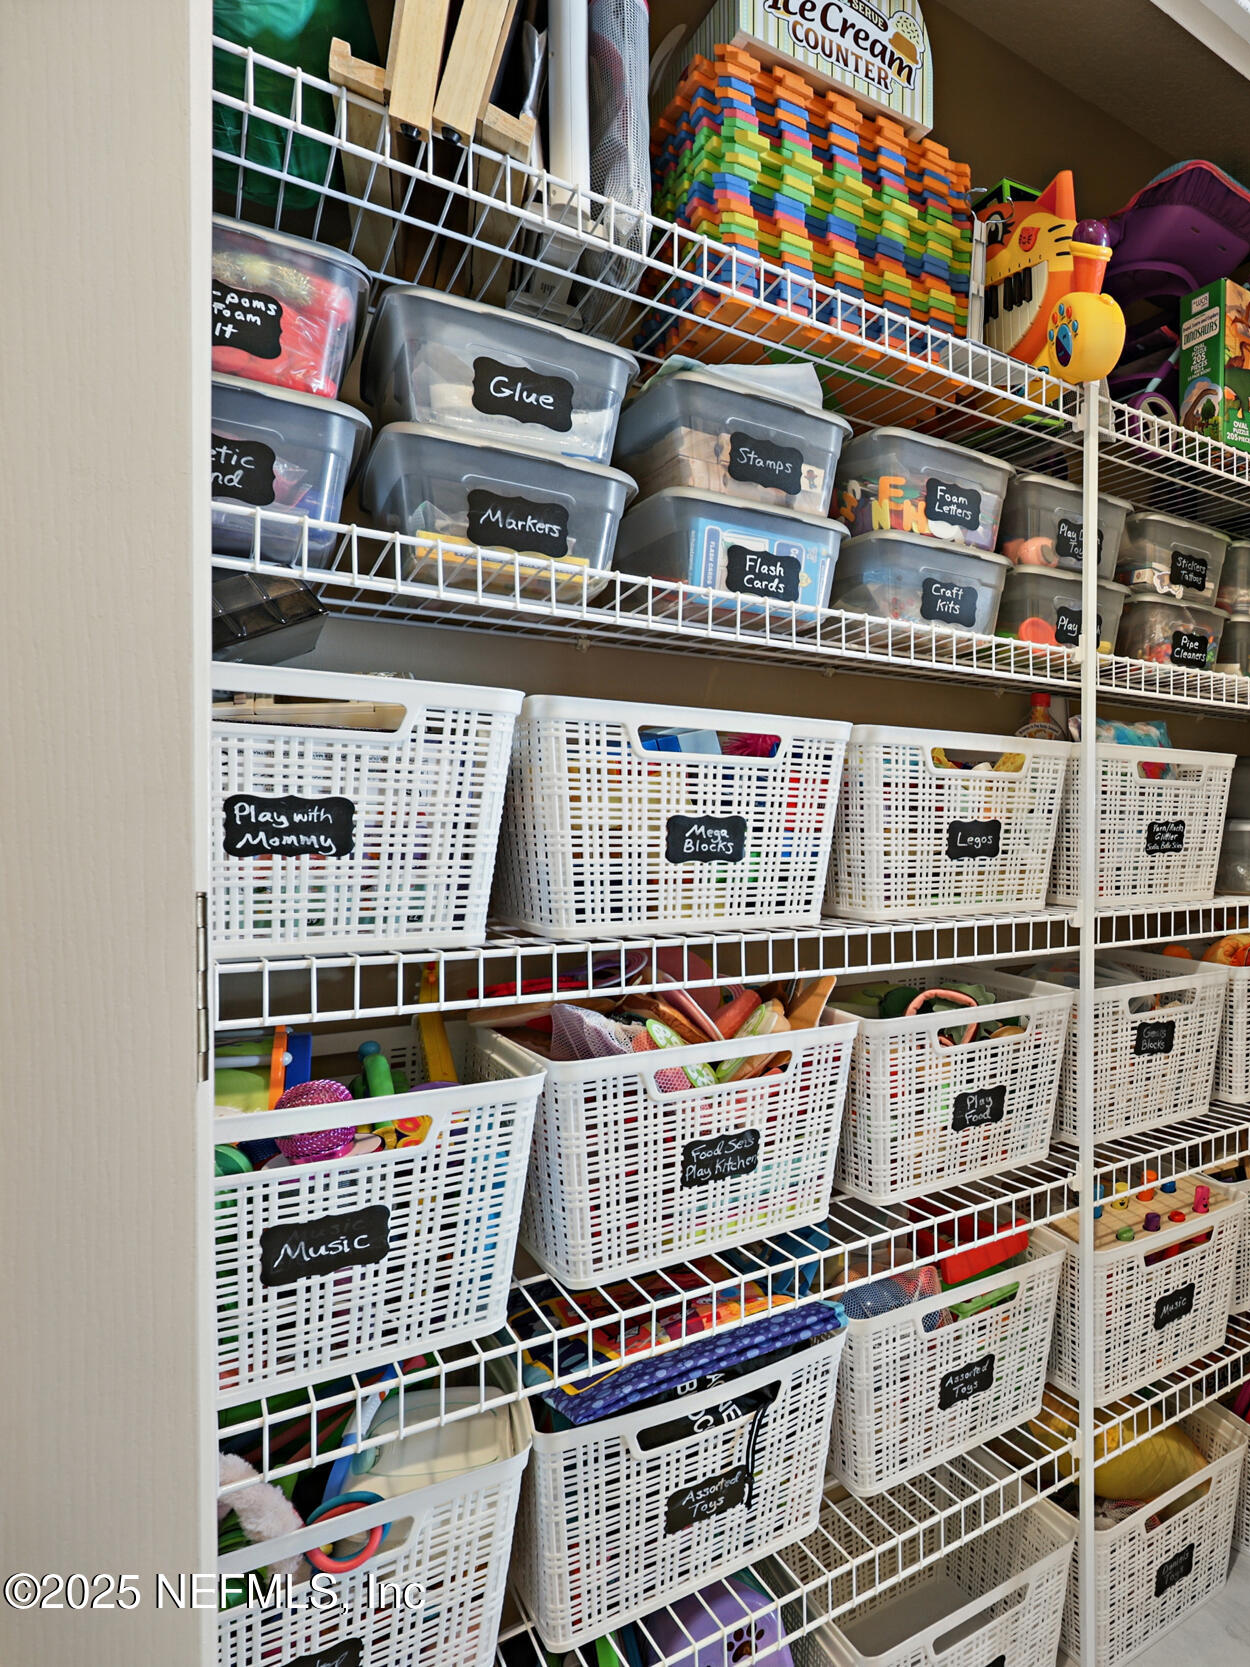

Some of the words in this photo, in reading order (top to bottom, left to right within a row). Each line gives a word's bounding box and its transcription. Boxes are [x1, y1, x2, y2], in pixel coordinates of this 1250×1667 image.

[851, 0, 885, 31] SERVE
[820, 2, 914, 86] Cream
[791, 20, 890, 91] COUNTER
[489, 376, 555, 410] Glue
[1233, 420, 1249, 430] OVAL
[1227, 432, 1239, 441] 205
[736, 447, 793, 475] Stamps
[936, 486, 969, 506] Foam
[934, 502, 973, 521] Letters
[479, 508, 562, 538] Markers
[1059, 523, 1077, 542] Play
[745, 555, 785, 577] Flash
[1176, 556, 1206, 575] Stickers
[743, 574, 785, 594] Cards
[931, 584, 963, 600] Craft
[936, 599, 961, 614] Kits
[1057, 616, 1079, 636] Play
[1181, 635, 1200, 650] Pipe
[1173, 648, 1207, 662] Cleaners
[233, 802, 290, 828] Play
[293, 806, 333, 824] with
[235, 831, 337, 855] Mommy
[685, 824, 730, 843] Mega
[956, 831, 994, 849] Legos
[683, 839, 734, 855] Blocks
[1141, 1039, 1166, 1051] Blocks
[966, 1095, 993, 1111] Play
[965, 1107, 992, 1125] Food
[691, 1140, 725, 1163] Food
[685, 1164, 713, 1182] Play
[714, 1154, 758, 1175] Kitchen
[273, 1234, 371, 1269] Music
[1160, 1296, 1188, 1319] Music
[945, 1359, 990, 1388] Assorted
[952, 1381, 979, 1399] Toys
[681, 1470, 743, 1506] Assorted
[688, 1496, 725, 1518] Toys
